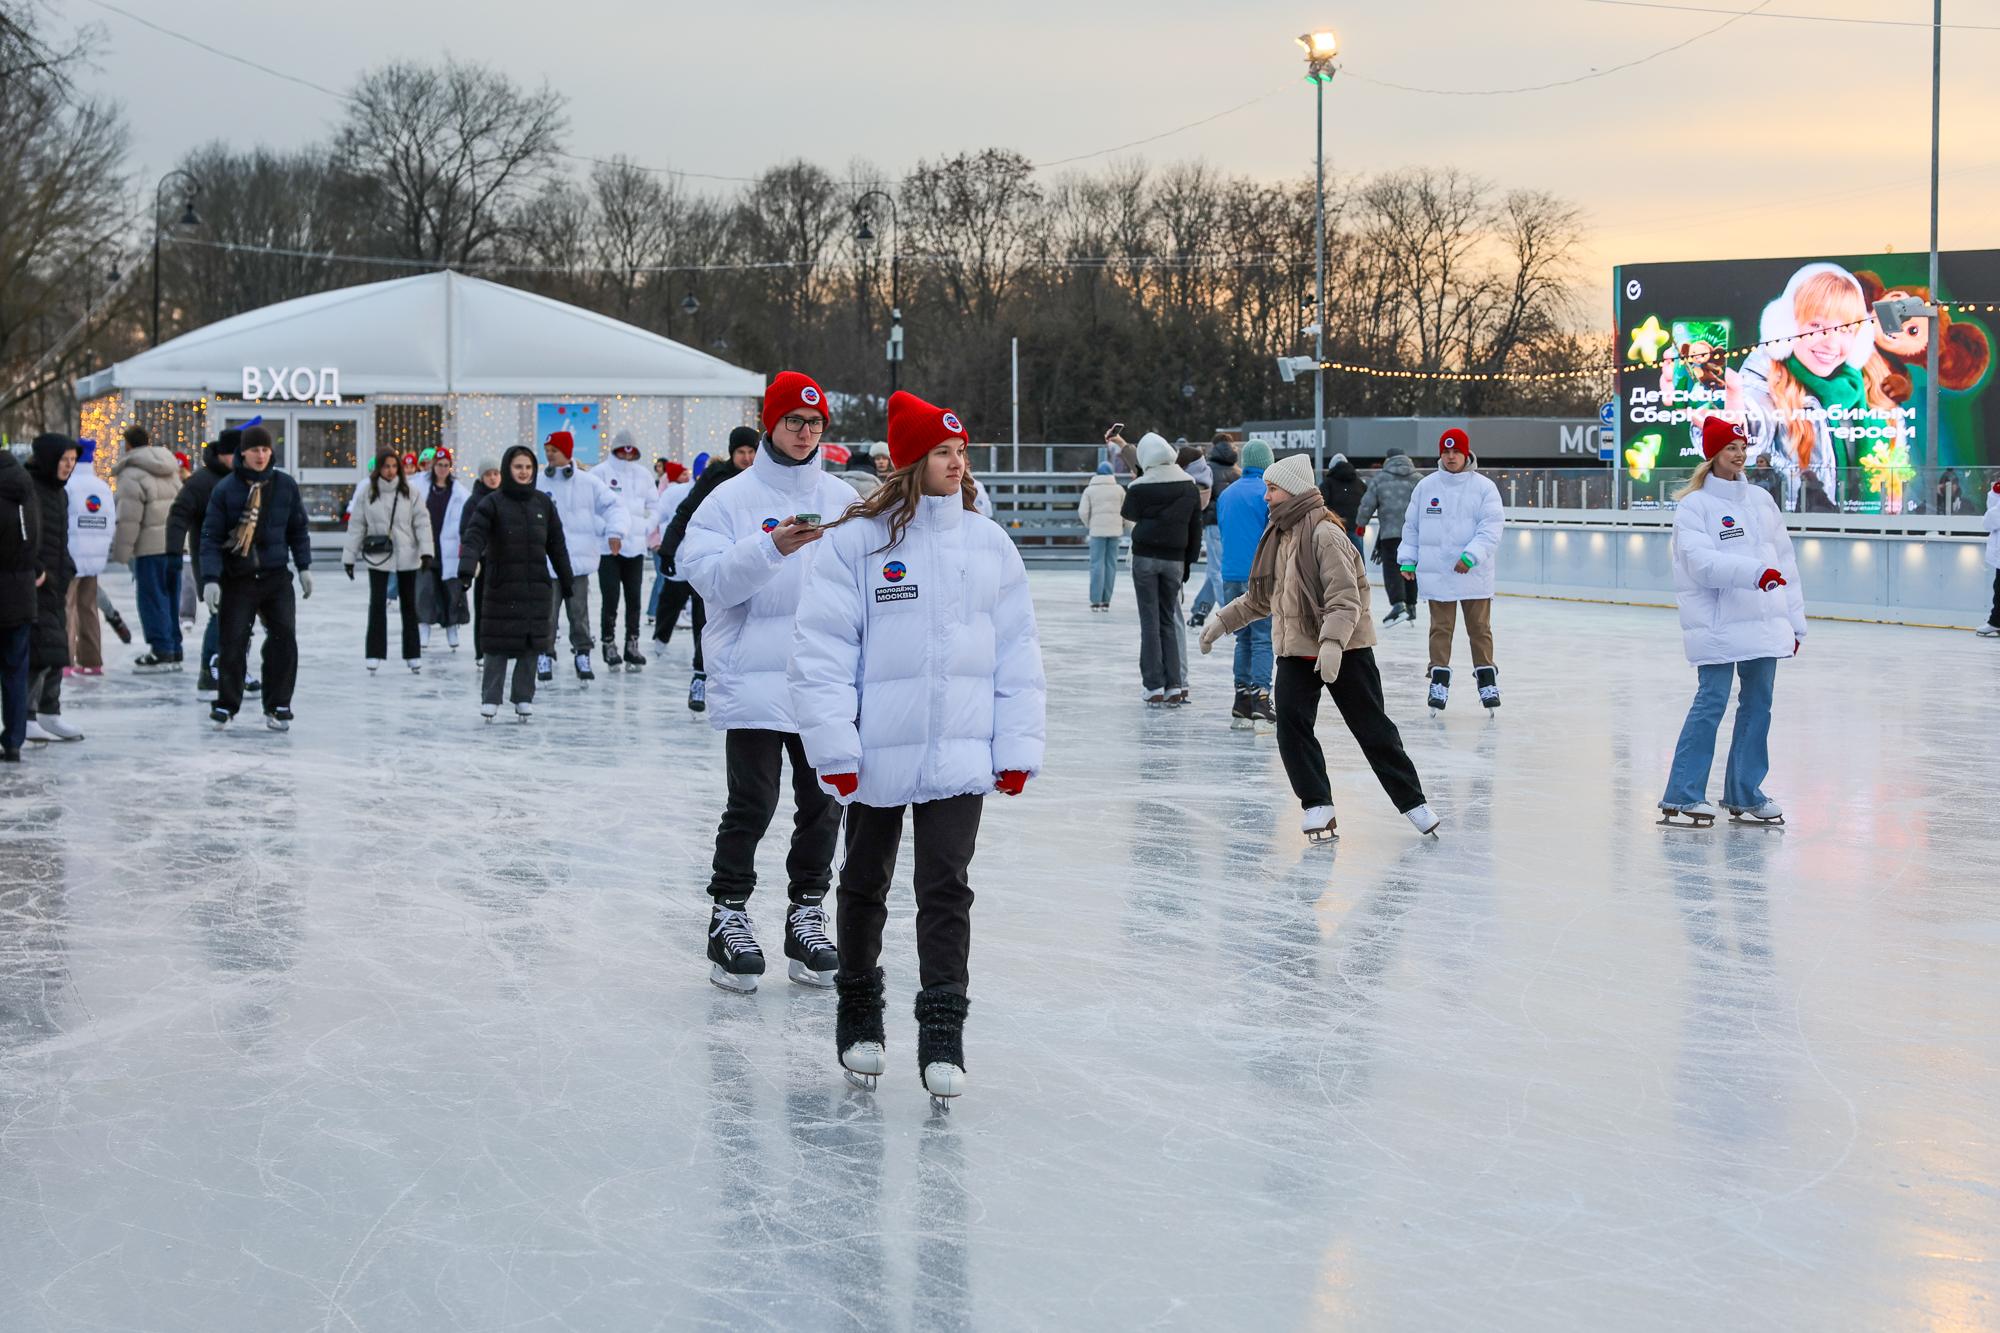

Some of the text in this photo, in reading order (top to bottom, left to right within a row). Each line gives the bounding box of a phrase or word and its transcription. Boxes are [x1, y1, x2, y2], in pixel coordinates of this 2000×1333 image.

[242, 366, 341, 406] ВХОД
[1629, 386, 1727, 405] Детская
[1824, 425, 1916, 442] героем
[877, 591, 917, 601] МОСКВЫ
